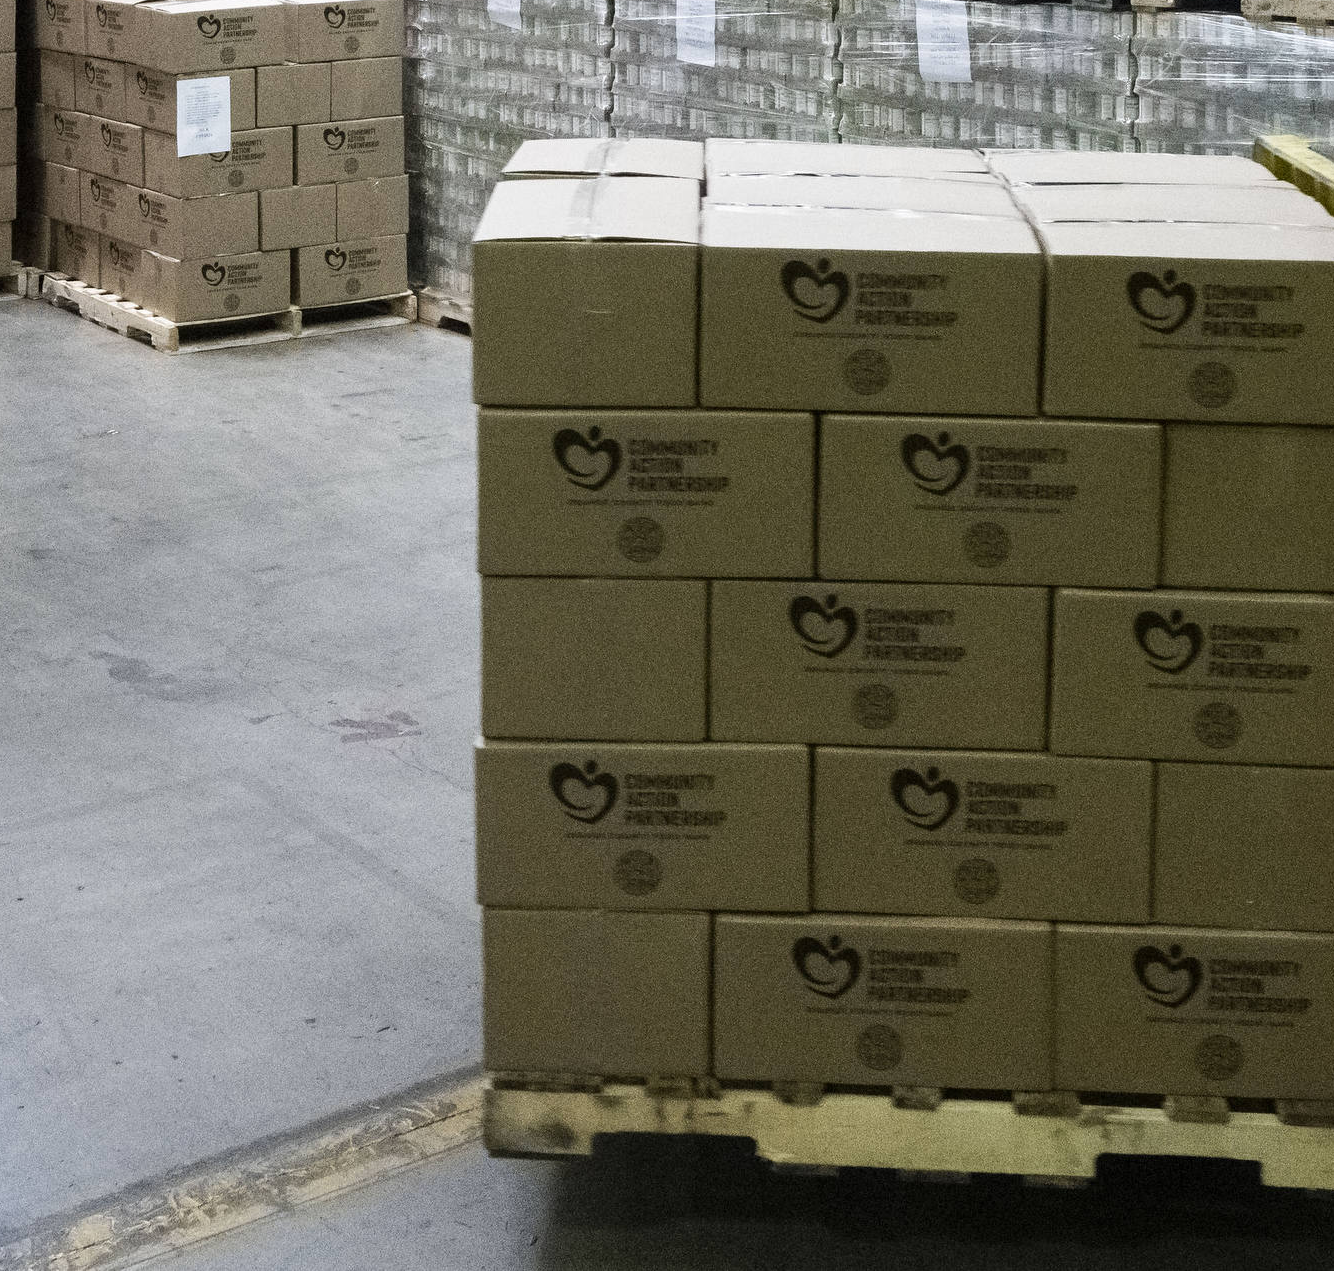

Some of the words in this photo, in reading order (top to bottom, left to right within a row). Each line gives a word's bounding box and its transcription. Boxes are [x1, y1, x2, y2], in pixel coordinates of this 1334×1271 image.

[857, 272, 948, 290] COMMUNITY
[856, 291, 911, 307] ACTION
[1203, 284, 1295, 302] COMMUNITY
[855, 309, 958, 327] PARTNERSHIP
[1202, 302, 1258, 319] ACTION
[1201, 321, 1304, 339] PARTNERSHIP
[629, 439, 718, 455] COMMUNITY
[977, 446, 1068, 464] COMMUNITY
[629, 458, 683, 473] ACTION
[976, 464, 1031, 480] ACTION
[628, 476, 729, 492] PARTNERSHIP
[975, 482, 1078, 501] PARTNERSHIP
[865, 608, 955, 625] COMMUNITY
[864, 626, 919, 642] ACTION
[1210, 624, 1301, 643] COMMUNITY
[864, 644, 965, 662] PARTNERSHIP
[1209, 643, 1264, 659] ACTION
[1208, 661, 1311, 681] PARTNERSHIP
[625, 773, 715, 790] COMMUNITY
[966, 781, 1057, 800] COMMUNITY
[625, 792, 679, 807] ACTION
[966, 799, 1020, 816] ACTION
[625, 810, 726, 826] PARTNERSHIP
[965, 817, 1067, 837] PARTNERSHIP
[869, 949, 959, 967] COMMUNITY
[868, 967, 923, 984] ACTION
[1209, 958, 1301, 977] COMMUNITY
[1209, 977, 1264, 993] ACTION
[867, 985, 969, 1004] PARTNERSHIP
[1208, 995, 1311, 1014] PARTNERSHIP
